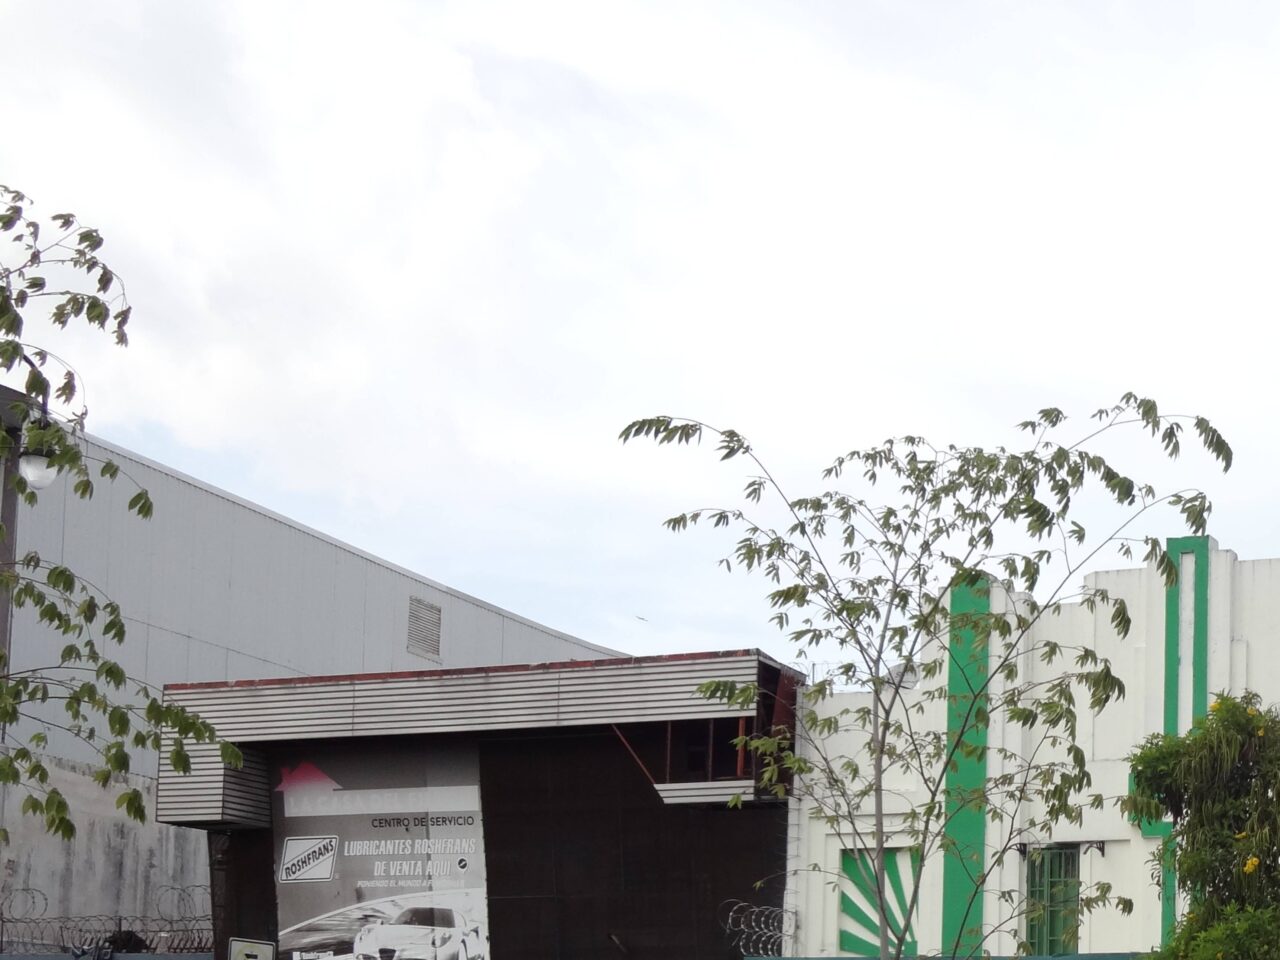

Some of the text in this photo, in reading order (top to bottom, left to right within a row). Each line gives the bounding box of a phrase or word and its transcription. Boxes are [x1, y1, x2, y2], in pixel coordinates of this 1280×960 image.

[371, 816, 475, 828] CENTRO DE SERVICIO
[344, 838, 476, 856] LUBRICANTES ROSHFRANS
[285, 840, 334, 879] ROSHFRANS
[374, 860, 451, 876] DE VENTA AQUI
